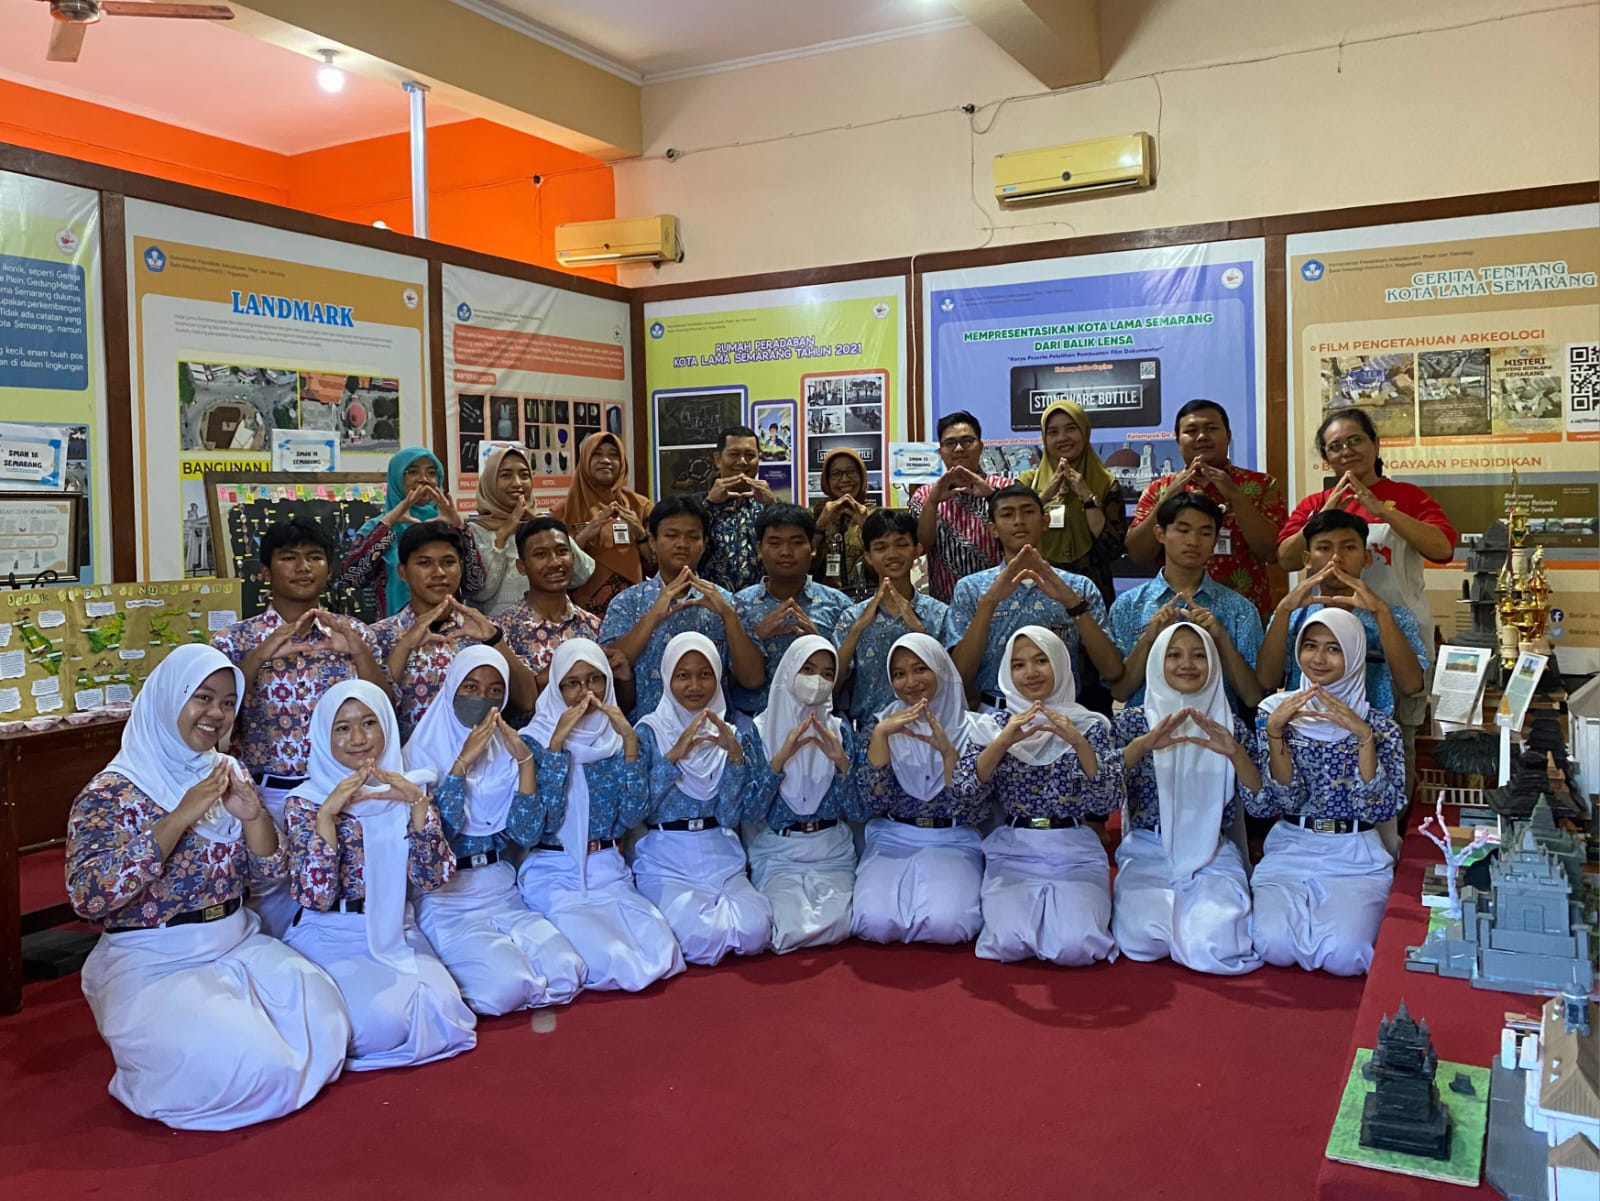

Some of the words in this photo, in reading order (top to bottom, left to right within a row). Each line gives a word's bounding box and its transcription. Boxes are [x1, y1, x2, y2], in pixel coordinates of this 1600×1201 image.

[28, 268, 54, 277] seperti
[1412, 269, 1475, 286] CERITA
[1480, 262, 1566, 280] TENTANG
[14, 286, 51, 300] Semarang
[1387, 287, 1433, 301] KOTA
[1438, 282, 1486, 298] LAMA
[1493, 274, 1595, 293] SEMARANG
[27, 300, 81, 313] perkembangan
[231, 291, 354, 327] LANDMARK
[20, 310, 34, 319] ada
[36, 312, 61, 321] catatan
[64, 315, 81, 325] yang
[57, 326, 81, 334] namun
[963, 323, 1075, 342] MEMPRESENTASIKAN
[1077, 321, 1108, 333] KOTA
[1110, 319, 1143, 331] LAMA
[1145, 312, 1214, 328] SEMARANG
[715, 341, 752, 353] RUMAH
[754, 335, 815, 350] PERADABAN
[1034, 340, 1061, 352] DARI
[1063, 337, 1095, 349] BALIK
[1097, 335, 1134, 347] LENSA
[1319, 343, 1350, 352] FILM
[1353, 335, 1456, 350] PENGETAHUAN
[1460, 329, 1545, 344] ARKEOLOGI
[27, 349, 48, 357] enam
[50, 349, 68, 359] buah
[70, 352, 83, 361] pos
[673, 356, 698, 368] KOTA
[701, 354, 731, 366] LAMA
[734, 348, 792, 363] SEMARANG
[796, 345, 832, 359] TAHUN
[835, 342, 862, 356] 2021
[1504, 357, 1546, 366] MISTERI
[10, 358, 18, 367] di
[20, 359, 43, 369] dalam
[45, 361, 84, 372] lingkungan
[1099, 389, 1137, 405] BOTTLE
[3, 460, 42, 468] SEMARANG
[183, 462, 265, 474] BANGUNAN
[1384, 459, 1446, 469] NGAYAAN
[1451, 456, 1542, 468] PENDIDIKAN
